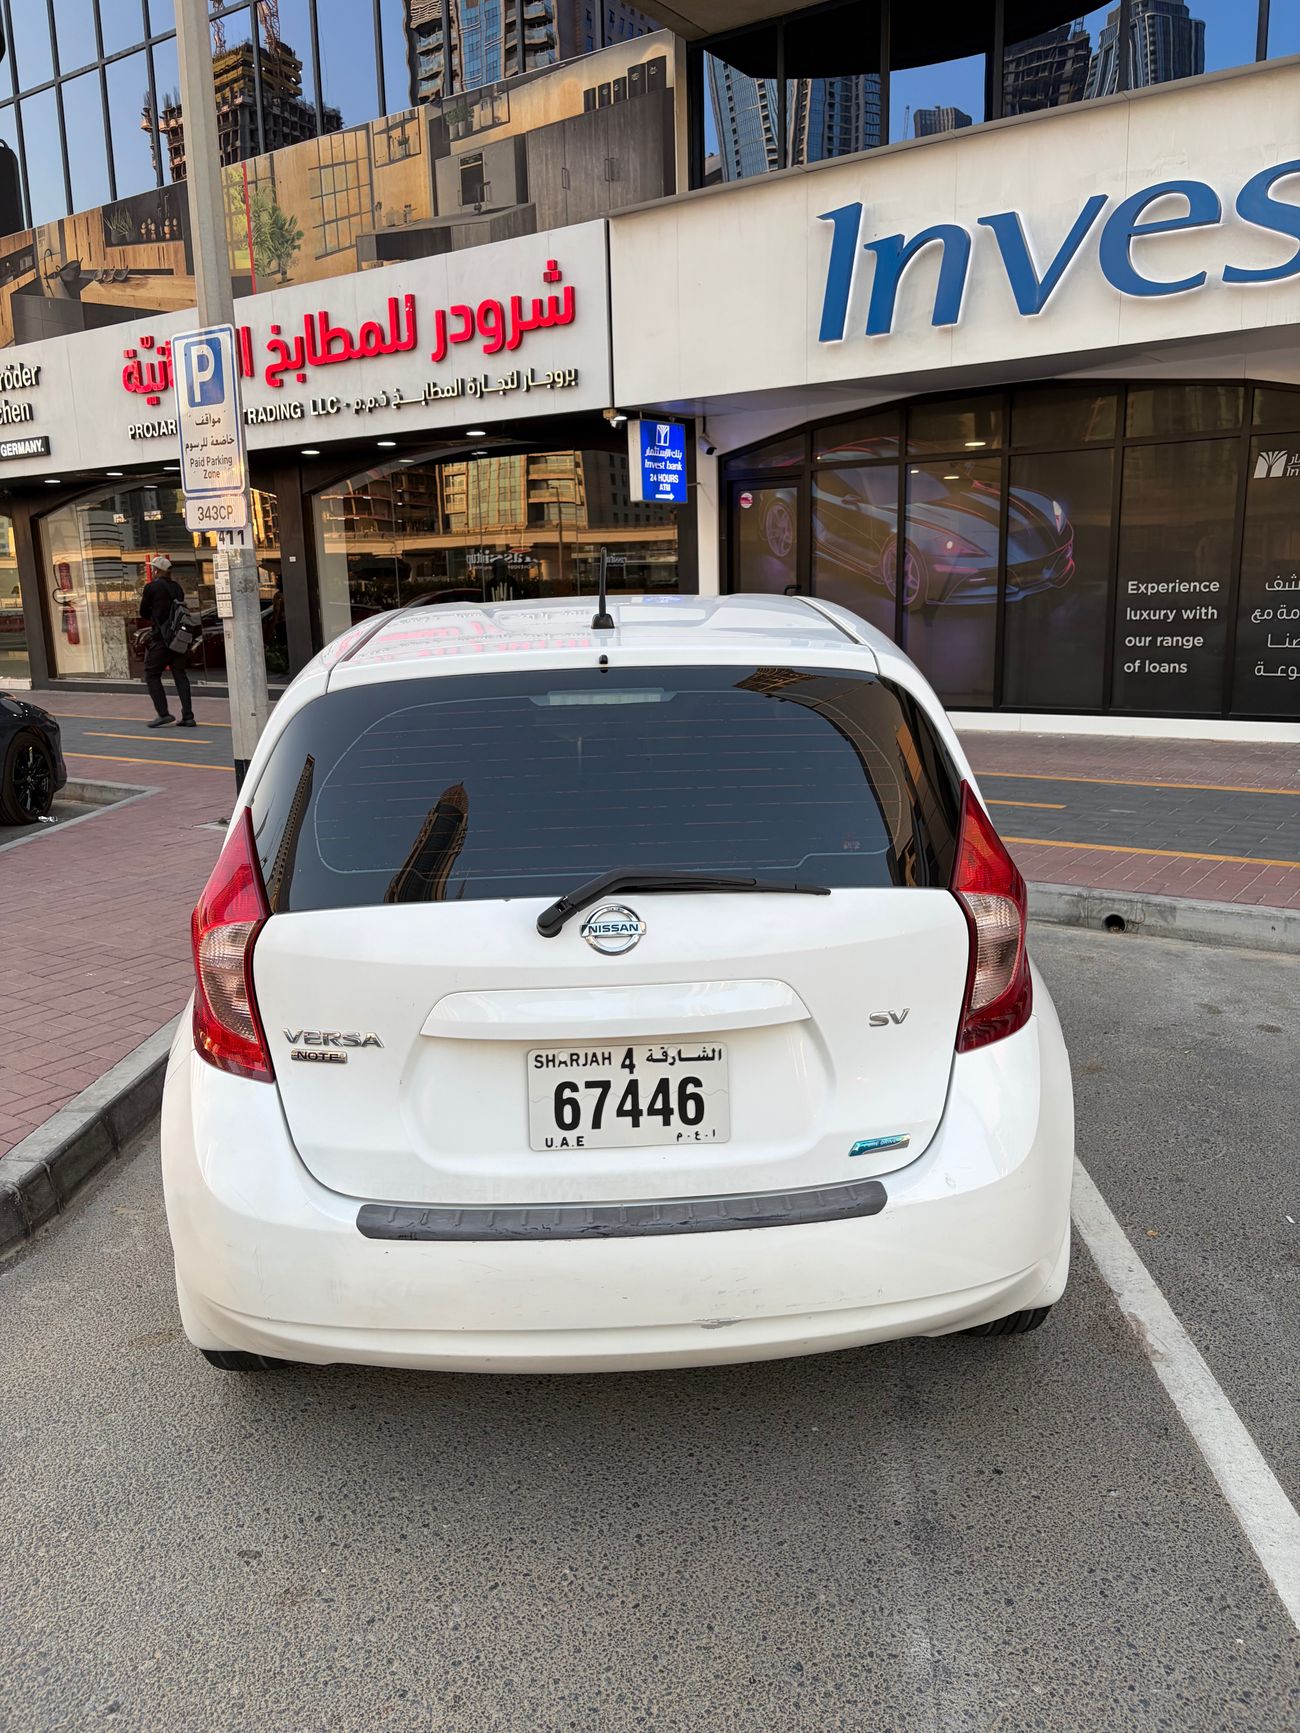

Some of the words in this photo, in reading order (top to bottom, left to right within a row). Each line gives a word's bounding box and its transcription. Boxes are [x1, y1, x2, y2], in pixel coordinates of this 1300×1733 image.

[816, 160, 1300, 343] Inves
[431, 259, 577, 362] شرودر
[264, 293, 417, 388] للمطابخ
[190, 344, 215, 403] P
[522, 367, 578, 392] بروجار
[467, 370, 520, 399] لتجارة
[0, 399, 34, 425] hen
[128, 419, 177, 440] PROJAR
[310, 396, 340, 416] LLC
[195, 413, 221, 428] مواقف
[185, 437, 208, 455] للرسوم
[211, 434, 235, 447] خاضعة
[190, 457, 205, 468] Paid
[206, 455, 233, 467] Parking
[645, 459, 665, 469] Invest
[666, 461, 682, 471] bank
[203, 469, 220, 479] Zone
[649, 474, 657, 482] 24
[658, 474, 679, 483] HOURS
[659, 484, 671, 492] ATM
[197, 505, 234, 521] 343CP
[1127, 579, 1220, 596] Experience
[1126, 607, 1176, 622] luxury
[1182, 606, 1218, 620] with
[1251, 608, 1273, 623] مع
[1125, 636, 1151, 647] our
[1157, 636, 1204, 649] range
[1124, 660, 1141, 673] of
[1145, 660, 1188, 673] loans
[588, 923, 639, 934] NISSAN
[869, 1007, 911, 1027] SV
[283, 1028, 384, 1048] VERSA
[296, 1050, 340, 1062] NOTE
[620, 1047, 636, 1075] 4
[645, 1046, 722, 1067] الشارقة
[553, 1076, 705, 1131] 67446
[545, 1135, 585, 1148] U.A.E
